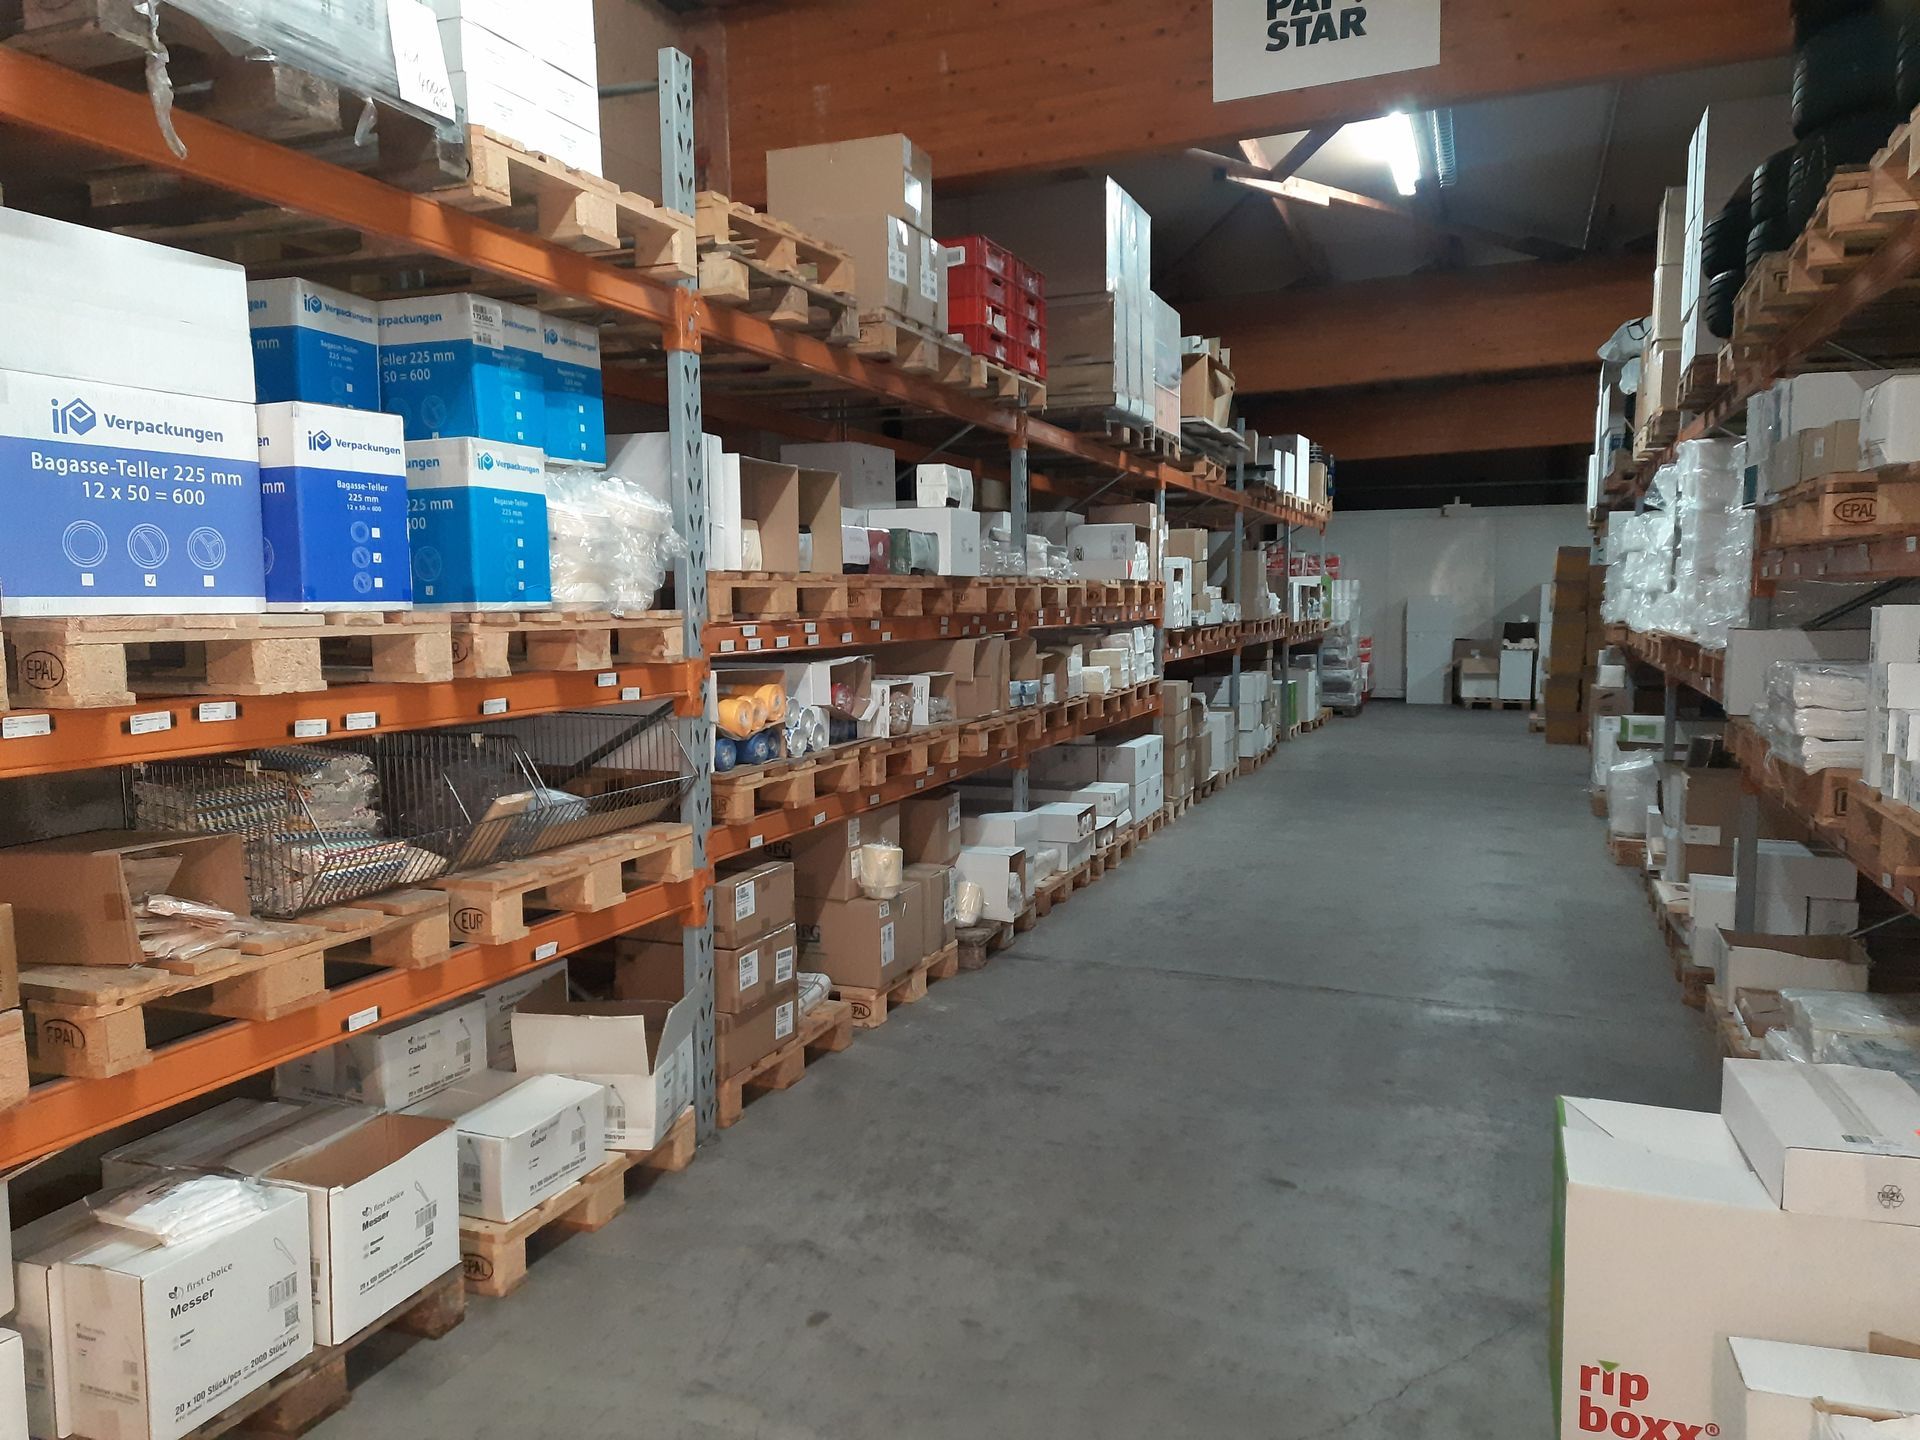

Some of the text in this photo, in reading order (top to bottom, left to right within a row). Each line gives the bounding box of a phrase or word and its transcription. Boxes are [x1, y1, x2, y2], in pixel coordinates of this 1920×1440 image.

[1266, 7, 1367, 51] STAR
[410, 351, 431, 364] 225
[433, 350, 455, 362] mm
[410, 368, 430, 381] 600
[104, 414, 223, 443] Verpackungen
[335, 438, 401, 456] Verpackungen
[31, 452, 242, 486] Bagasse-Teller 225 mm
[496, 460, 540, 474] Verpackungen
[82, 481, 105, 498] 12
[111, 487, 122, 500] x
[127, 484, 149, 501] 50
[172, 488, 206, 505] 600
[262, 481, 285, 493] mm
[336, 480, 388, 492] Bagasse-Teller
[348, 493, 379, 503] 225 mm
[430, 499, 454, 511] mm
[1842, 503, 1876, 518] EPAL
[27, 660, 57, 681] EPAL
[408, 1043, 427, 1055] Gabel
[362, 1210, 390, 1231] Messer
[186, 1263, 233, 1293] first choice
[170, 1288, 215, 1319] Messer
[175, 1403, 185, 1416] 20
[187, 1400, 191, 1409] x
[193, 1390, 206, 1403] 100
[250, 1352, 268, 1368] 2000
[1580, 1361, 1649, 1408] rip
